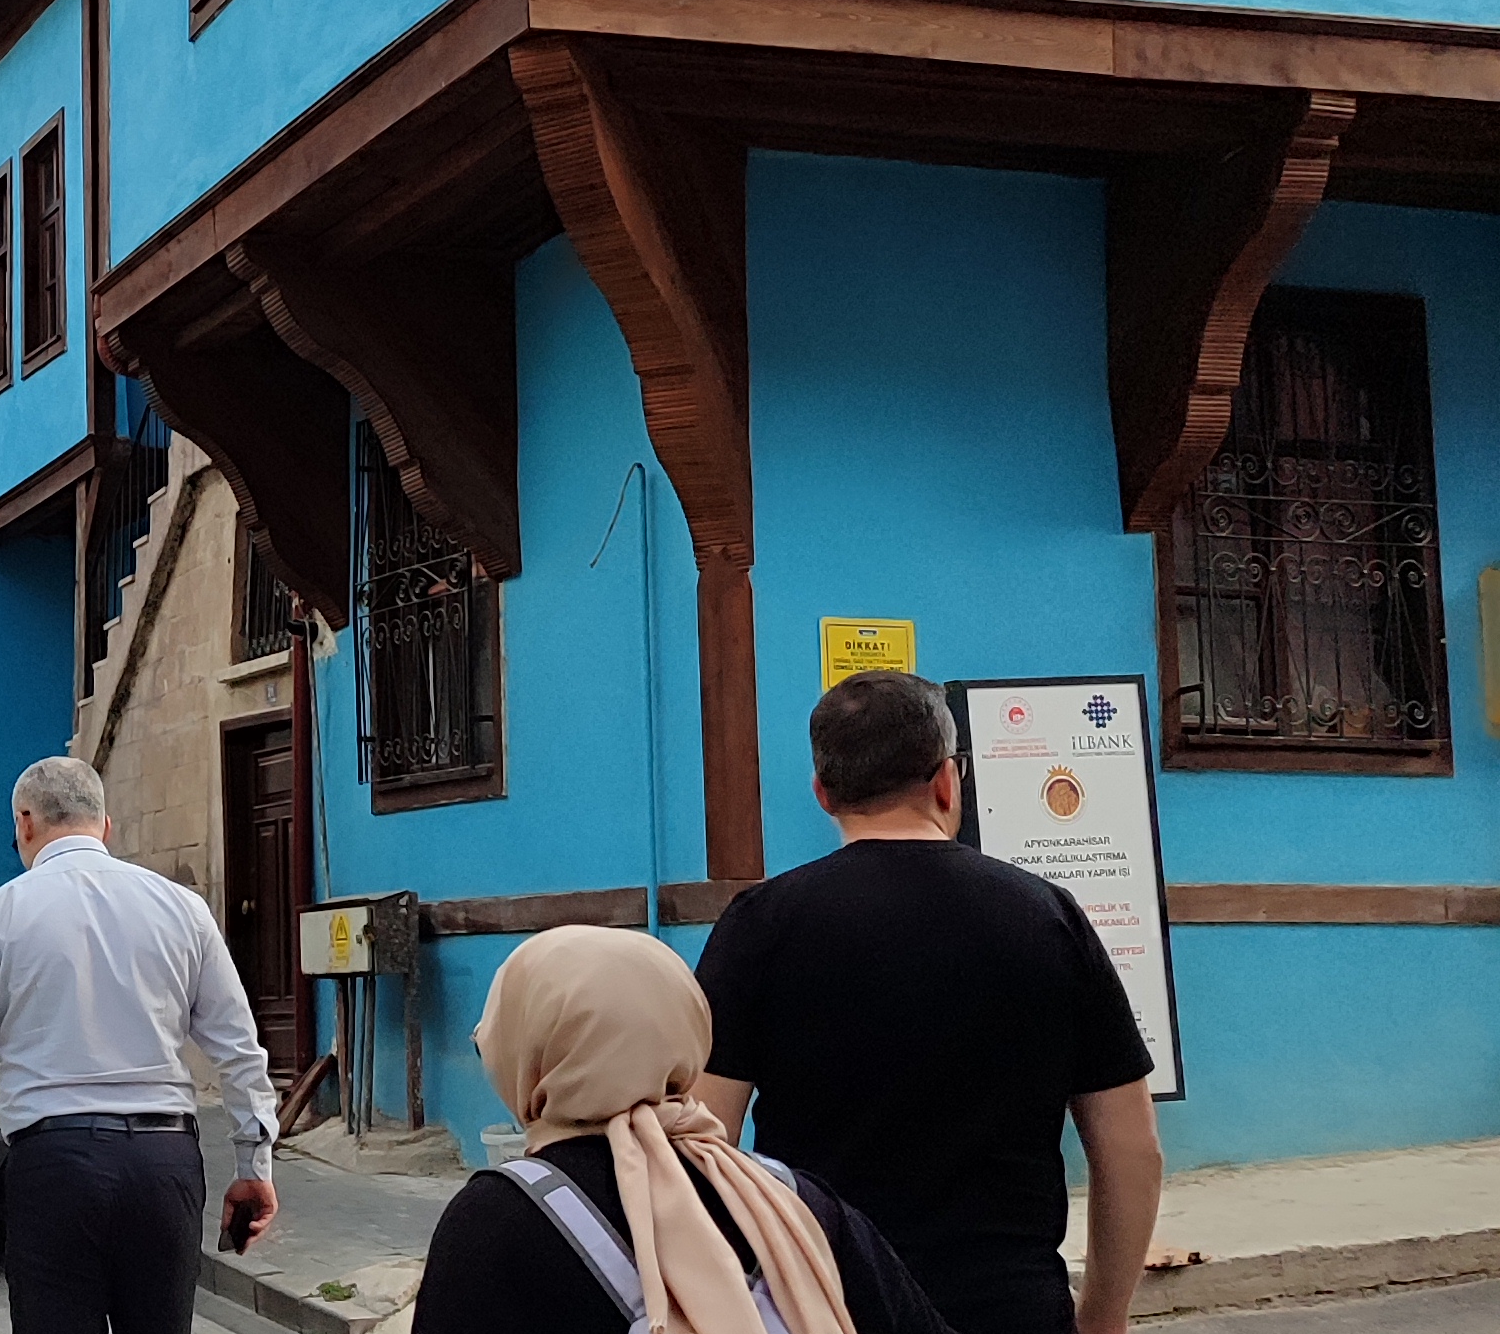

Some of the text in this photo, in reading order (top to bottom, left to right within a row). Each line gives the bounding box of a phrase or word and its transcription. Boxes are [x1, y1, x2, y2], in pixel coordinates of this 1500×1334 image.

[1024, 836, 1111, 849] AFYONKARAHİSAR
[1010, 852, 1128, 865] SOKAK SAĞLIKLAŞTIRMA
[1036, 865, 1131, 880] AMALARI YAPIM İŞİ
[1119, 902, 1131, 912] VE
